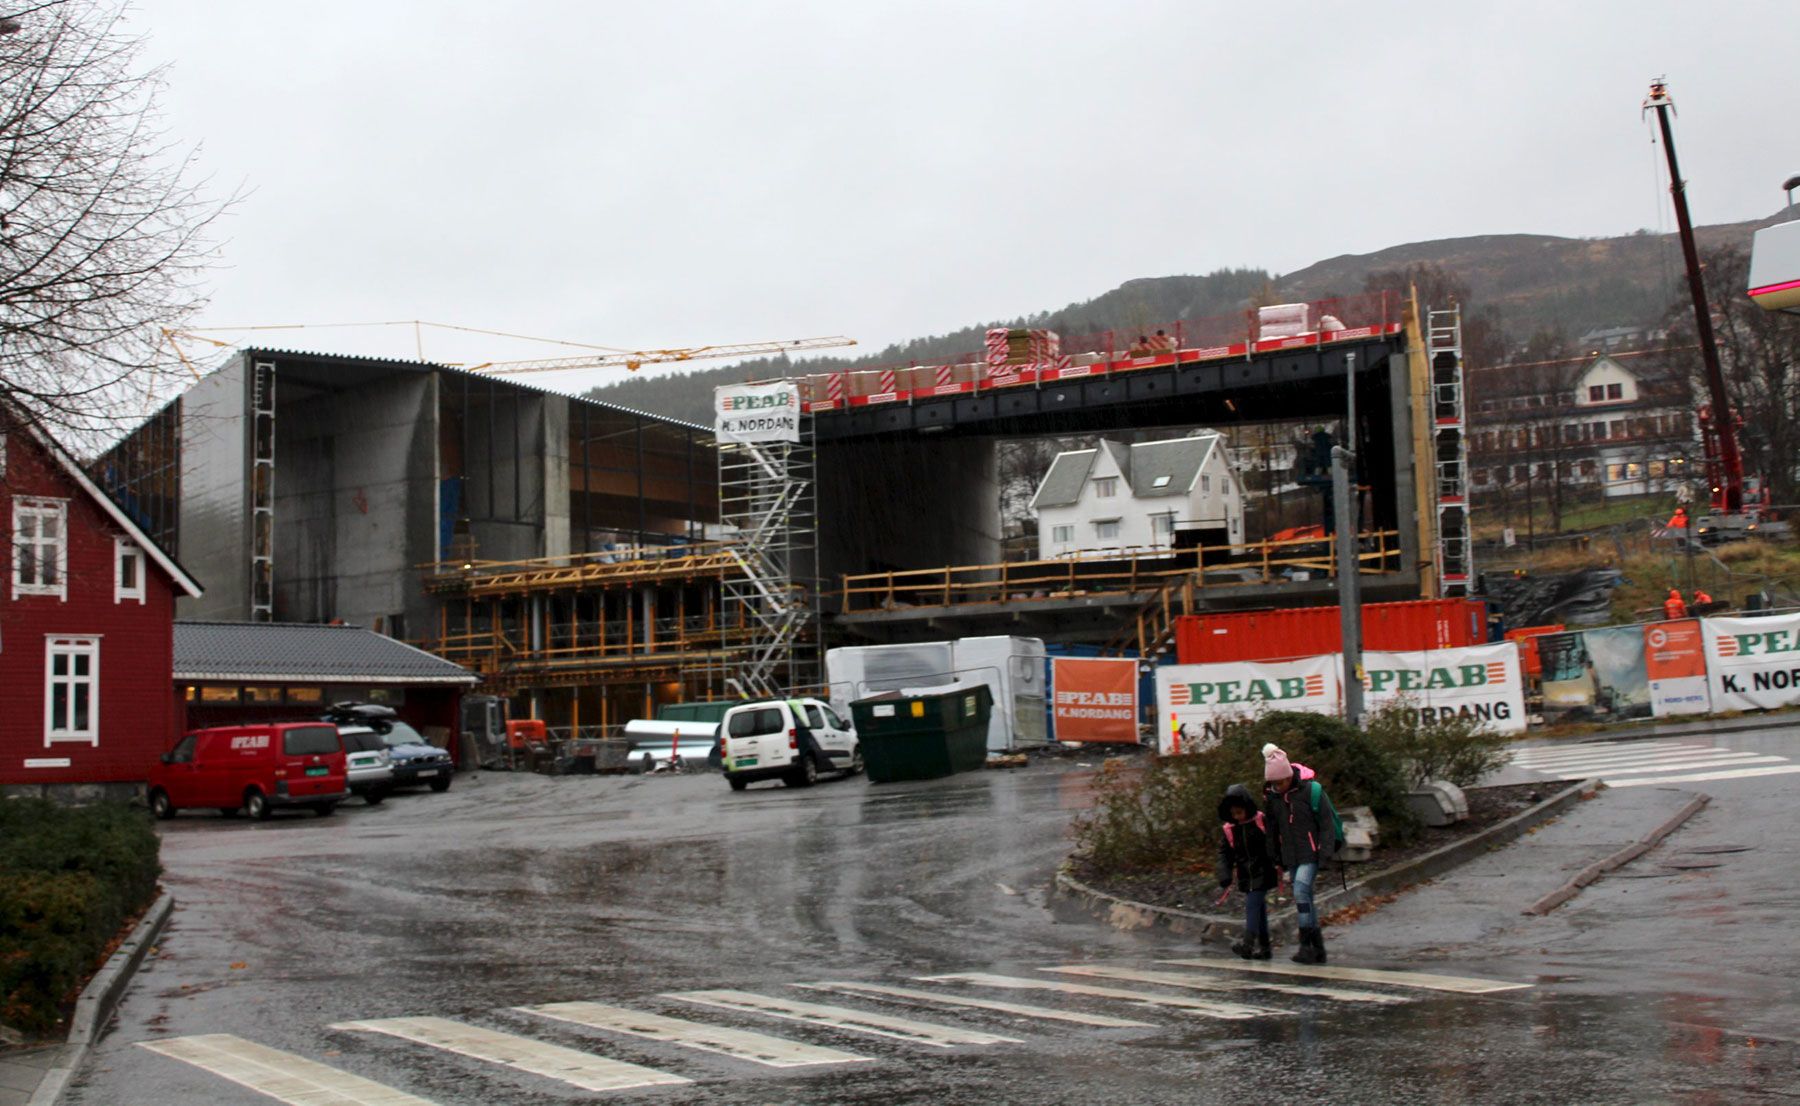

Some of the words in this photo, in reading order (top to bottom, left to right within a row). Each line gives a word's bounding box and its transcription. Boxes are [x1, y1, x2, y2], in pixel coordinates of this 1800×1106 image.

[733, 392, 790, 410] PEAB
[1368, 663, 1487, 692] PEAB
[1722, 674, 1746, 694] K.
[1066, 691, 1123, 705] PEAB
[1188, 677, 1306, 705] PEAB
